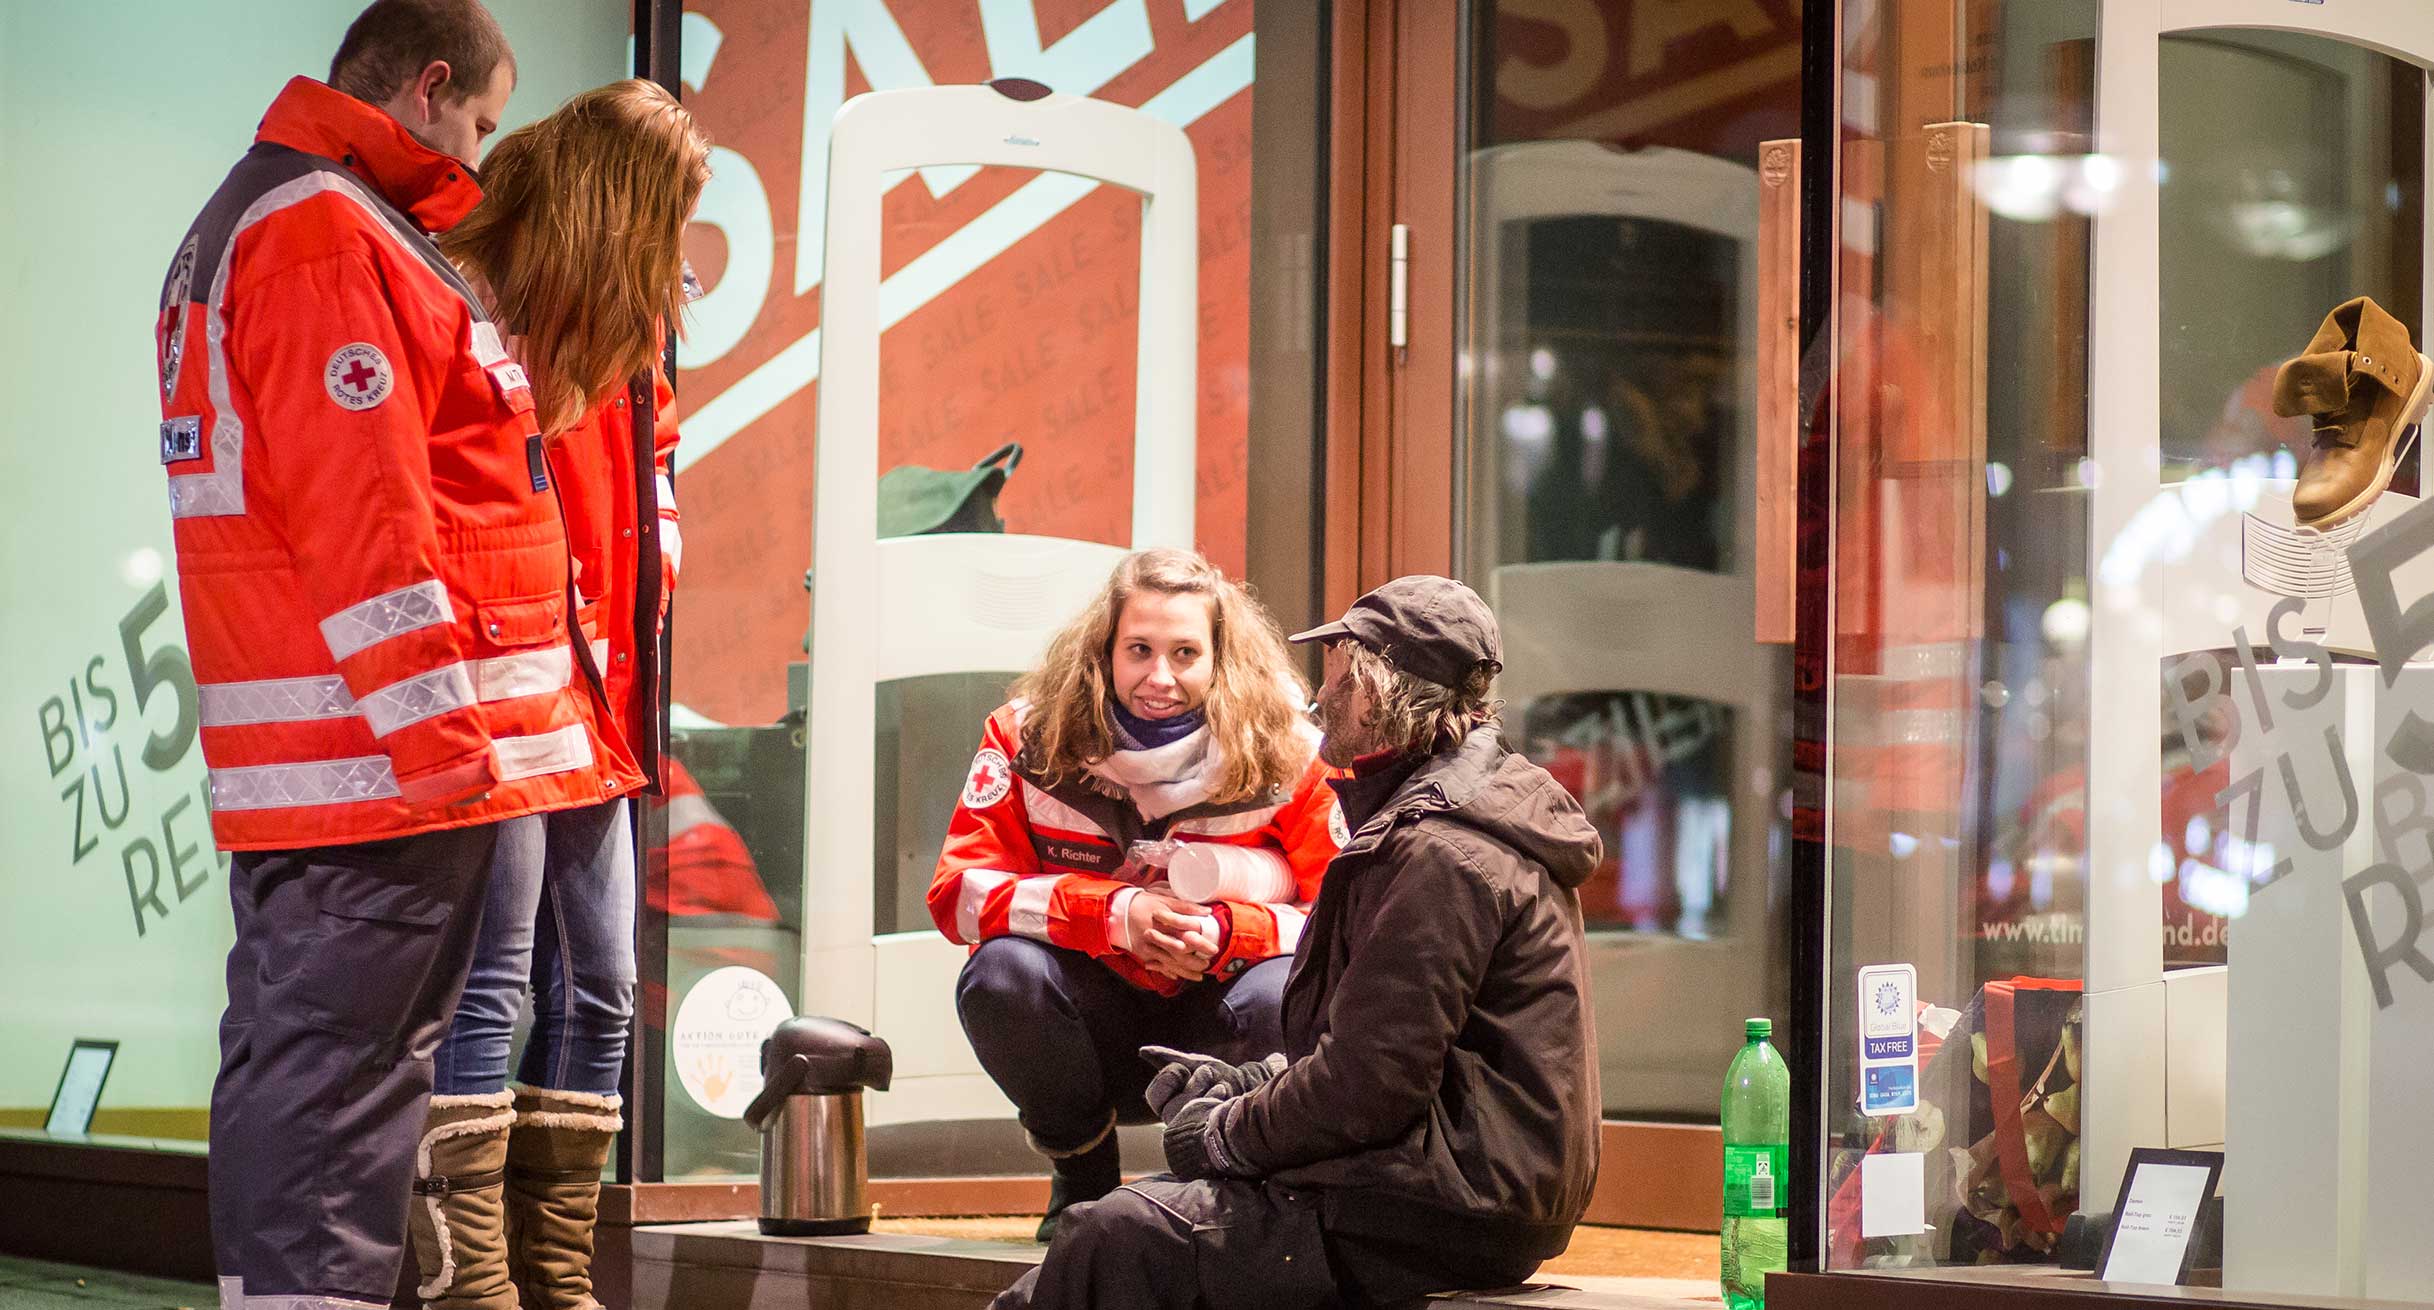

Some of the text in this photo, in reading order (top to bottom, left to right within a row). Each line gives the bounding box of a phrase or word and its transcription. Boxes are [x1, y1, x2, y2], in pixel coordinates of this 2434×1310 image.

[1077, 282, 1136, 344] SAL
[330, 348, 382, 377] DEUTSCHES
[333, 371, 388, 405] ROTES KREUZ
[38, 654, 118, 779] BIS
[2163, 596, 2333, 775] BIS
[61, 743, 130, 866] ZU
[2215, 724, 2359, 896] ZU
[1048, 846, 1101, 863] K. Richter
[1870, 1041, 1908, 1054] TAX FREE
